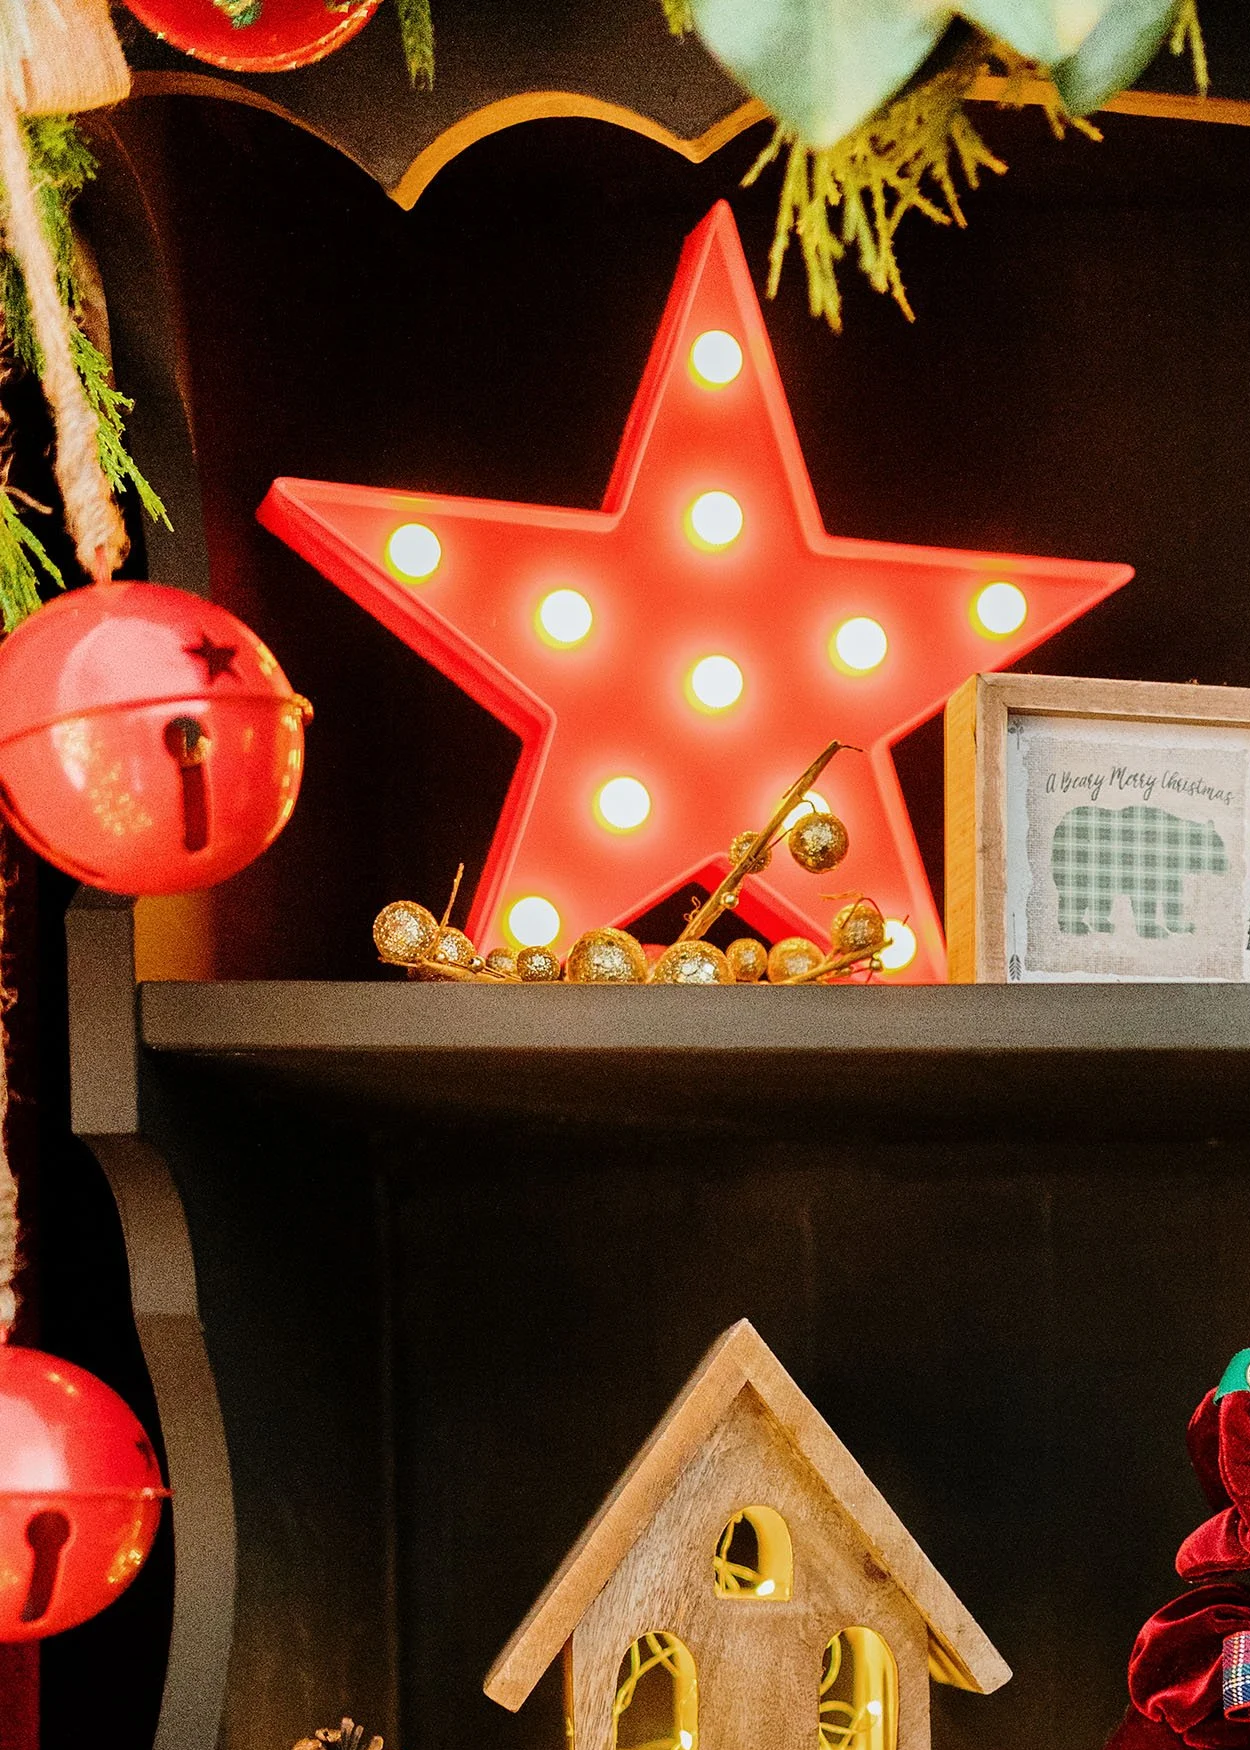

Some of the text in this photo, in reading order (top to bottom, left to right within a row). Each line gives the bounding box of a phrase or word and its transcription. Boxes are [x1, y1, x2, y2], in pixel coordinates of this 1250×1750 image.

[1045, 765, 1236, 806] A Beary Merry Christmas
